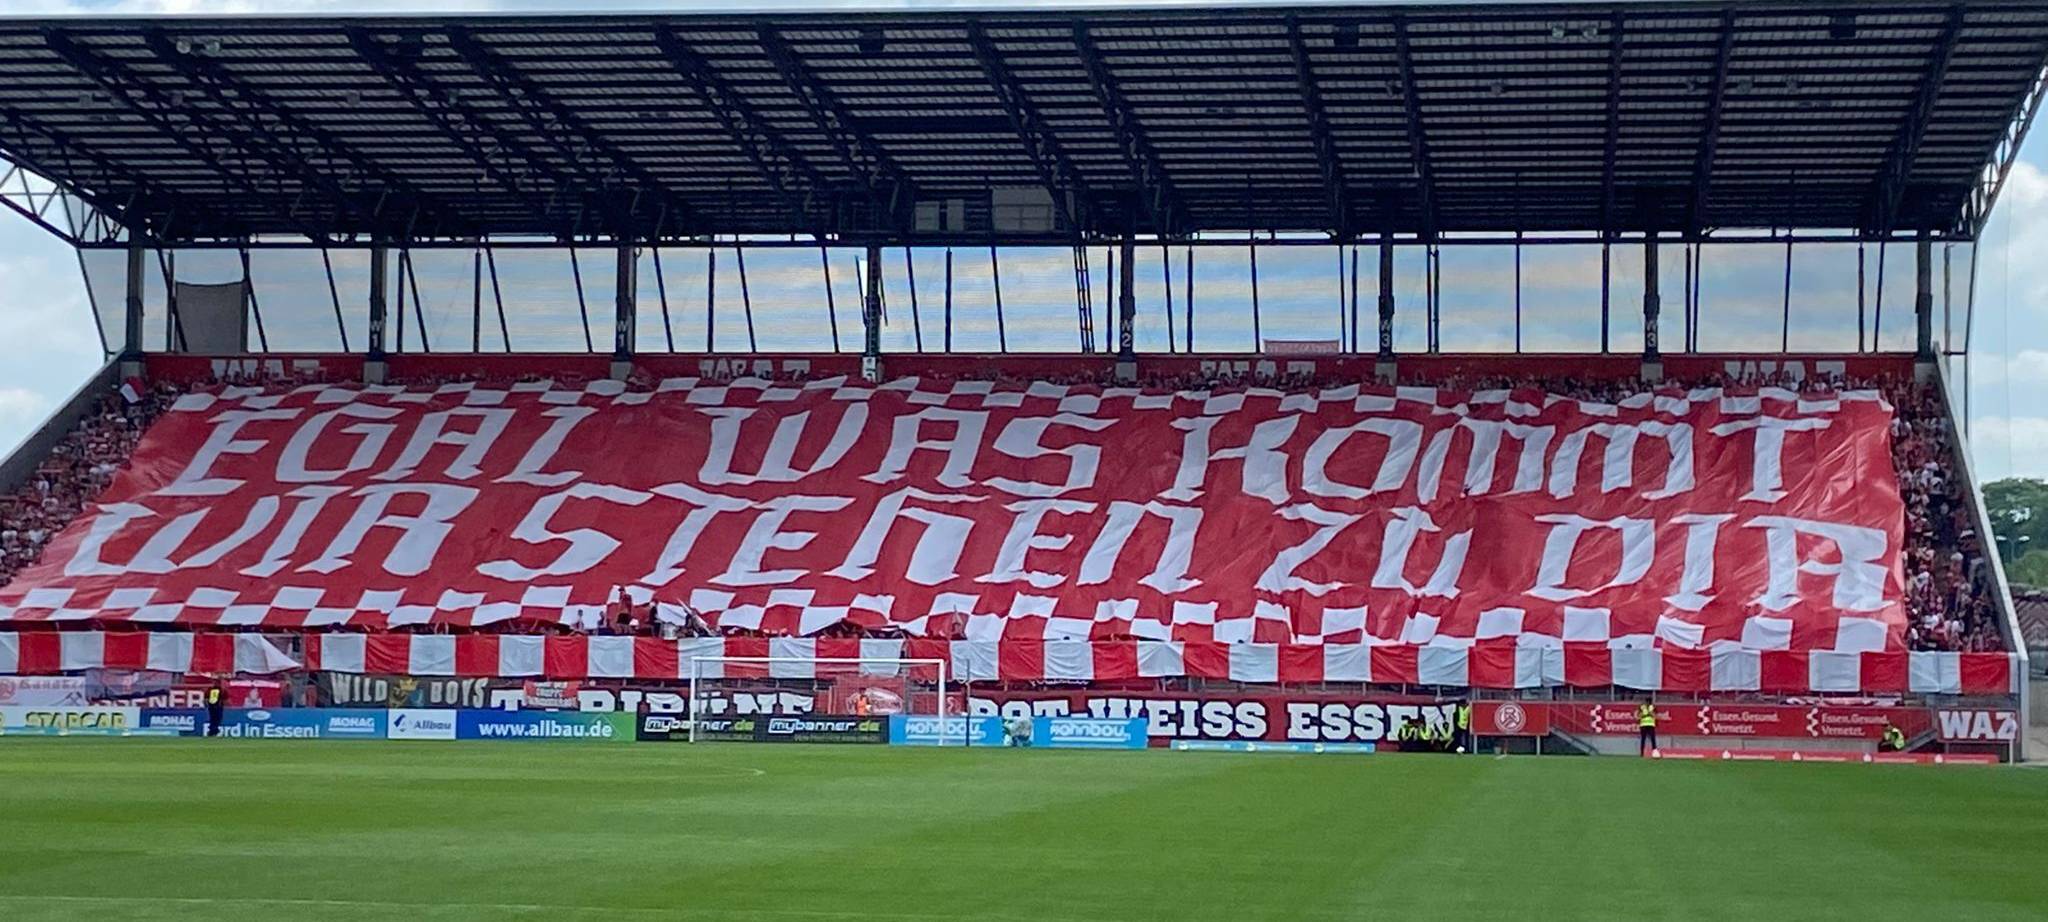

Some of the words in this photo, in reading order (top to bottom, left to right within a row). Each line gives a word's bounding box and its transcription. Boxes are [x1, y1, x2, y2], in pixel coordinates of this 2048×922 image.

[1122, 333, 1131, 347] 2
[1382, 334, 1390, 347] 3
[1647, 333, 1656, 347] 3
[154, 403, 599, 496] EGAL
[696, 402, 1120, 498] WAS
[1157, 412, 1832, 504] KOMMT
[64, 482, 480, 577] WIR
[477, 482, 1204, 594] STEHEN
[1256, 504, 1473, 599] ZU
[1522, 514, 1894, 612] DIR
[330, 673, 388, 704] WILD
[430, 677, 489, 708] BOYS
[25, 711, 126, 728] STARCAR
[151, 716, 195, 726] MOHAG
[329, 717, 375, 727] MOHAG
[414, 720, 451, 730] Allbau
[769, 719, 881, 733] mybanner.de
[967, 697, 1267, 738] ROT-WEISS
[1287, 702, 1457, 742] ESSEN
[1938, 711, 2016, 740] WAZ
[264, 723, 320, 738] Essen!
[478, 720, 613, 737] www.allbau.de
